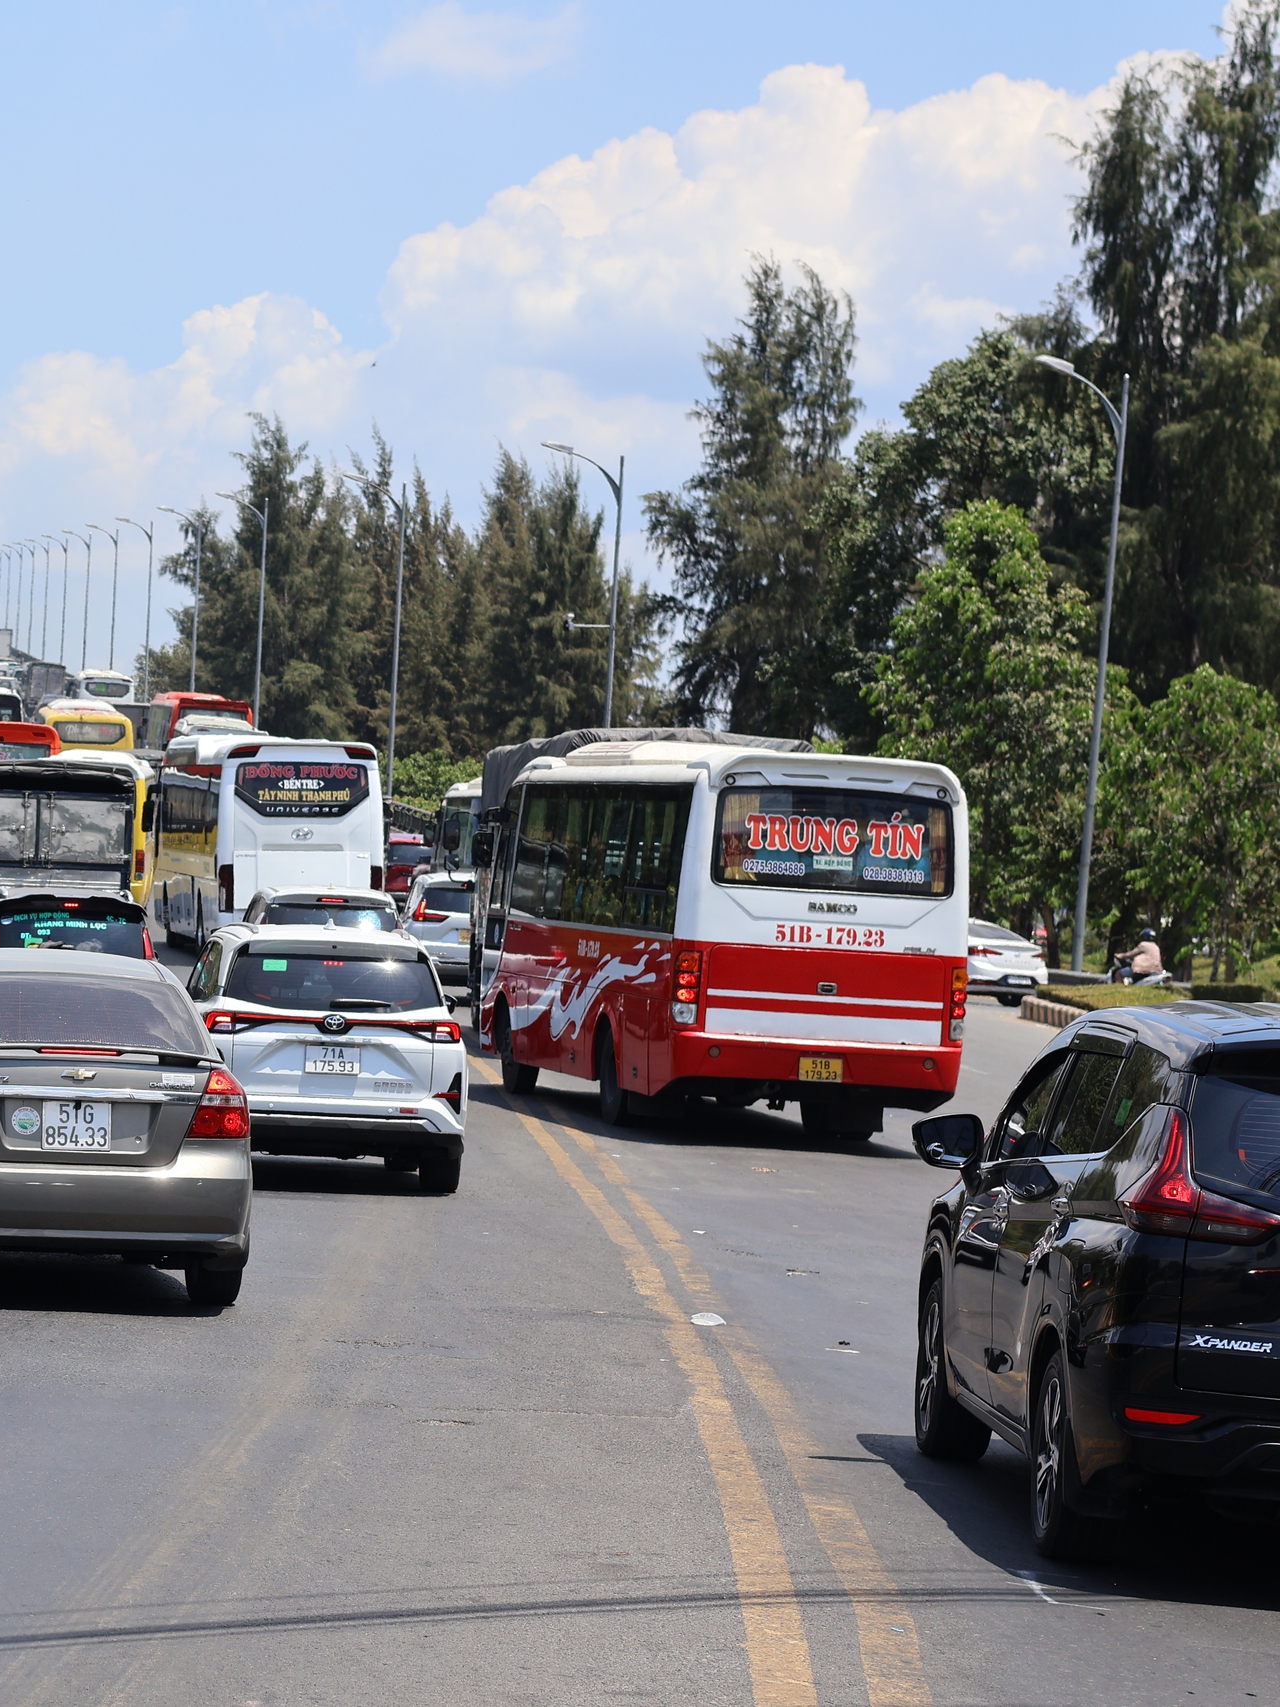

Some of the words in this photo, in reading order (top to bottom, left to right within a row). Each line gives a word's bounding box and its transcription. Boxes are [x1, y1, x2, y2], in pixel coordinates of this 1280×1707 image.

[300, 763, 358, 779] PHƯỚC
[257, 788, 277, 801] TÂY
[277, 790, 299, 801] NINH
[301, 790, 333, 803] THẠNH
[266, 806, 339, 814] UNIVERSE
[745, 812, 859, 855] TRUNG
[867, 811, 925, 860] TÍN
[742, 858, 805, 877] 0275.3864686
[862, 866, 925, 884] 028.38381313
[13, 914, 28, 923] DỊCH
[29, 912, 38, 921] VỤ
[321, 1047, 345, 1060] 71A
[312, 1060, 354, 1073] 175.93
[811, 1060, 830, 1070] 51B
[804, 1070, 837, 1080] 179.23
[149, 1082, 194, 1090] CHEVROLET
[373, 1081, 414, 1089] CROSS
[59, 1103, 94, 1124] 51G
[45, 1125, 108, 1148] 854.33
[1188, 1334, 1273, 1353] XPANDER
